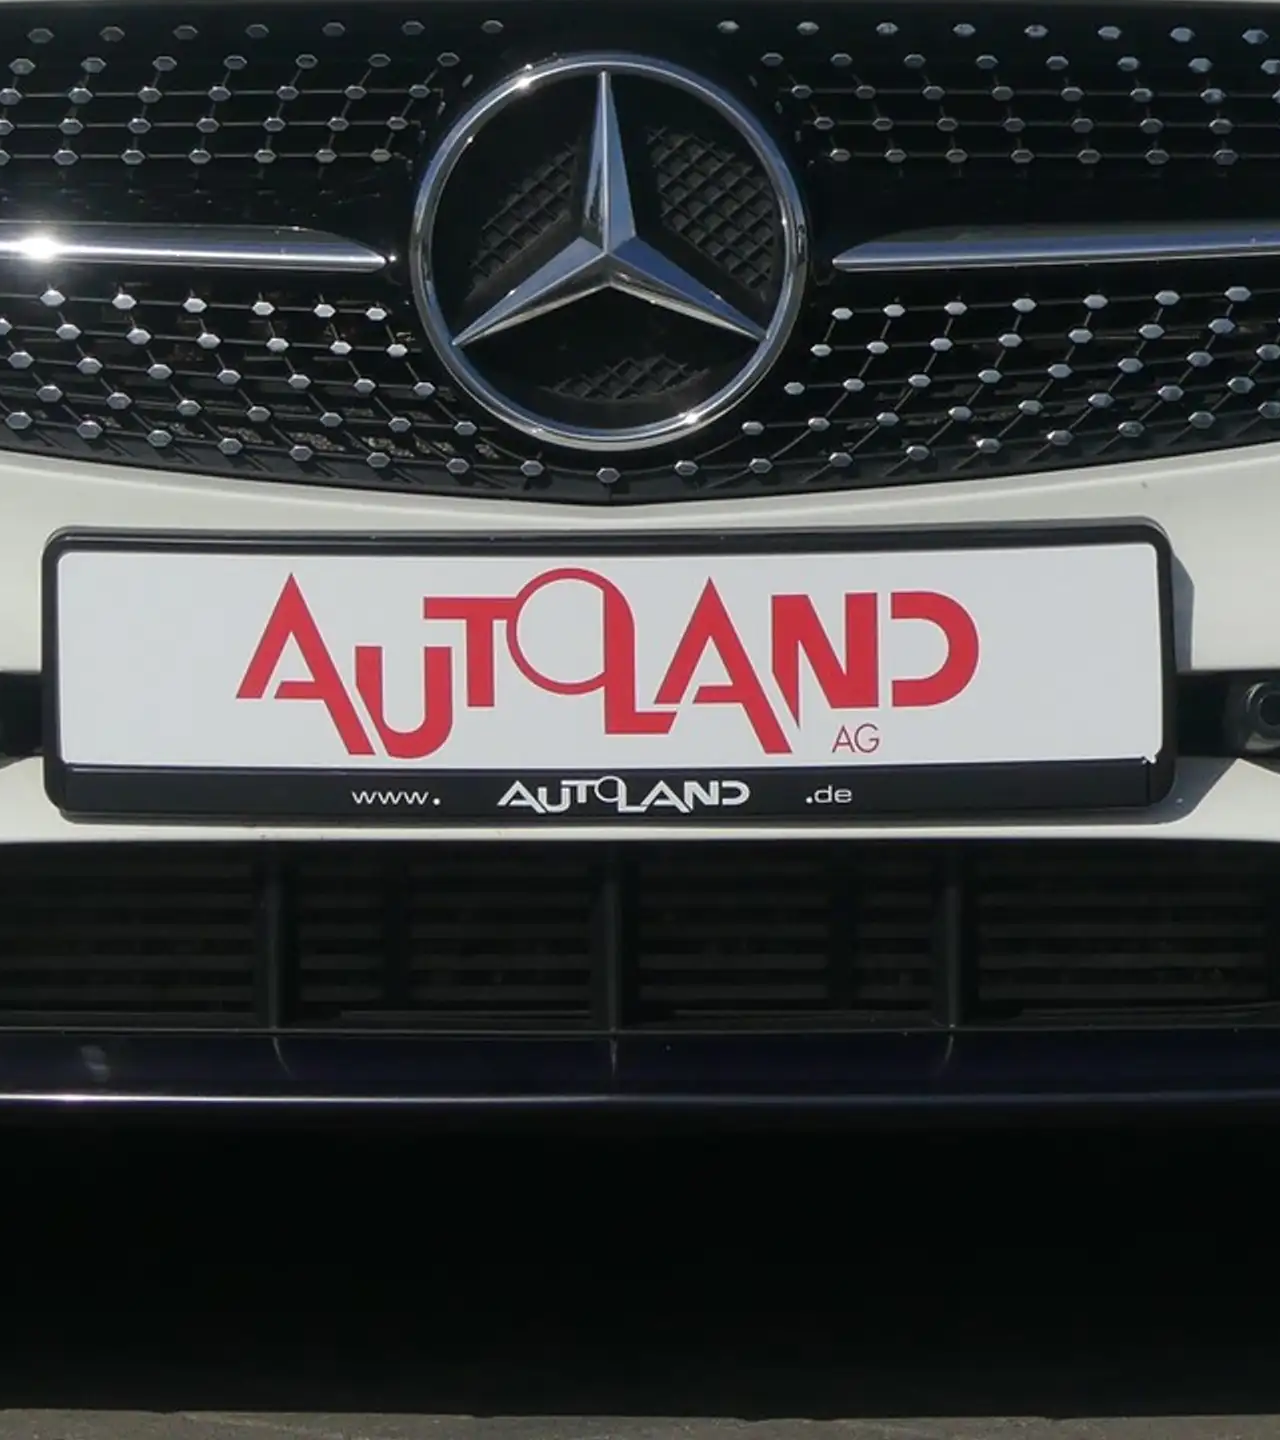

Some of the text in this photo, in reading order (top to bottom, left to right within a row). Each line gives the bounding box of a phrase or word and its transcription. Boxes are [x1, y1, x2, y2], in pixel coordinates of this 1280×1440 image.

[830, 722, 882, 755] AG
[350, 790, 442, 807] www.
[804, 784, 854, 805] .de
